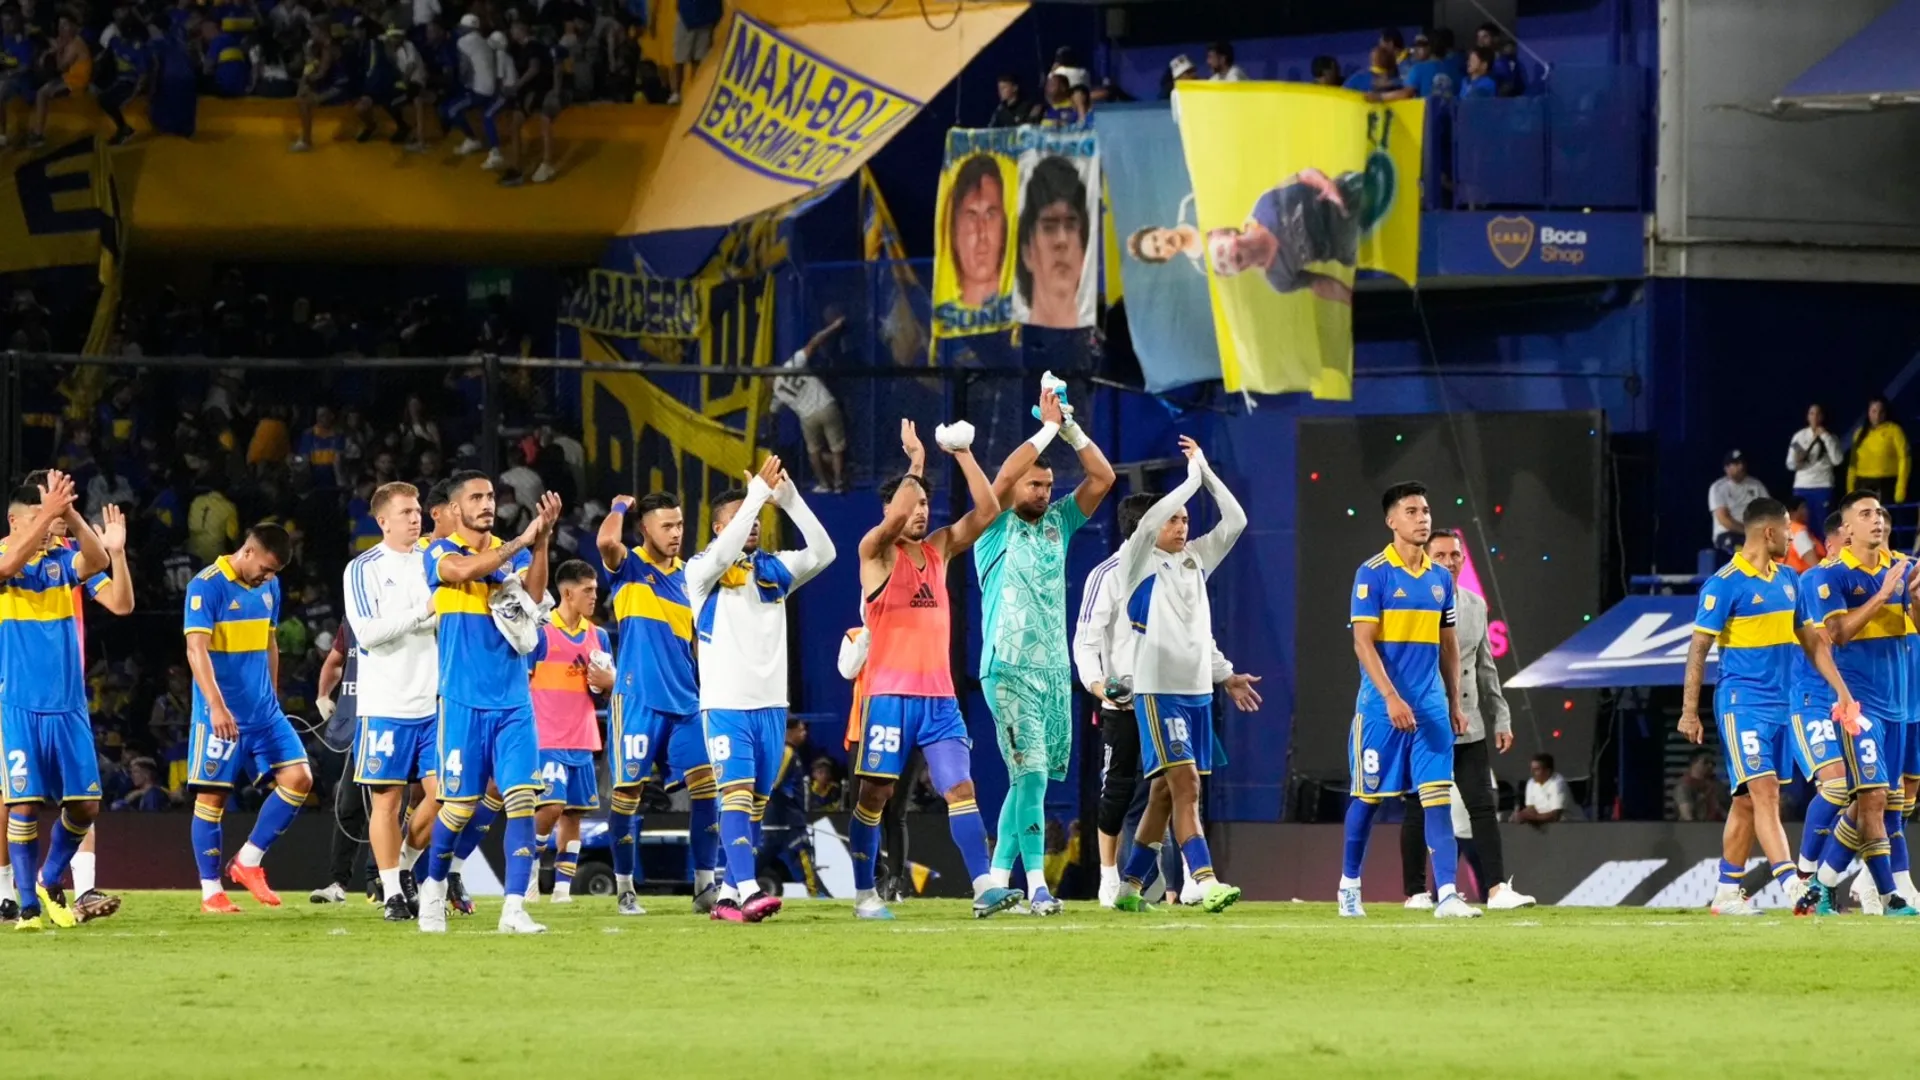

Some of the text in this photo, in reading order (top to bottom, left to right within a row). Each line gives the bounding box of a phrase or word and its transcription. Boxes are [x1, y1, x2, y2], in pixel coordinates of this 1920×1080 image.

[1541, 226, 1587, 244] Boca
[1541, 245, 1584, 265] Shop
[909, 600, 938, 608] adidas
[367, 730, 394, 757] 14
[869, 724, 901, 753] 25
[1740, 730, 1760, 755] 5
[1806, 718, 1837, 746] 28
[206, 733, 237, 761] 57
[624, 734, 649, 760] 10
[1859, 738, 1877, 764] 3
[8, 749, 28, 777] 2
[446, 748, 462, 776] 4
[542, 761, 568, 786] 44
[1363, 748, 1380, 774] 8
